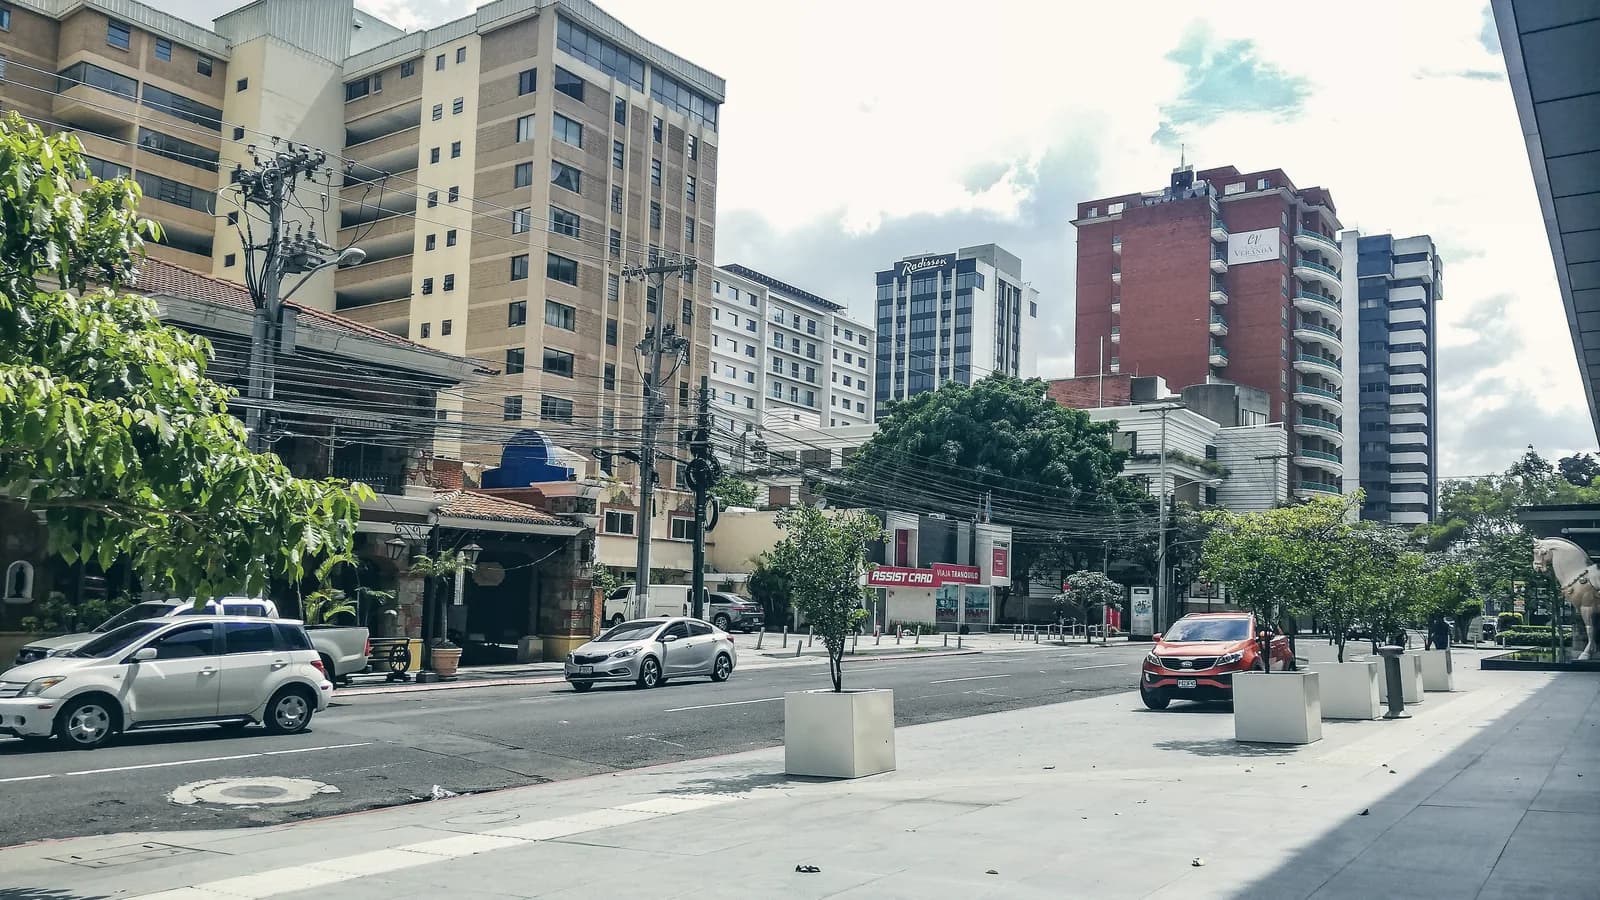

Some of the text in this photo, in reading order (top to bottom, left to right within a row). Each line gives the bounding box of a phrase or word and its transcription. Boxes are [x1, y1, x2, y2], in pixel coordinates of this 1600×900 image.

[902, 256, 947, 276] Radisson
[872, 571, 933, 583] ASSIST CARD
[937, 569, 979, 579] VIAJA TRANQUILO
